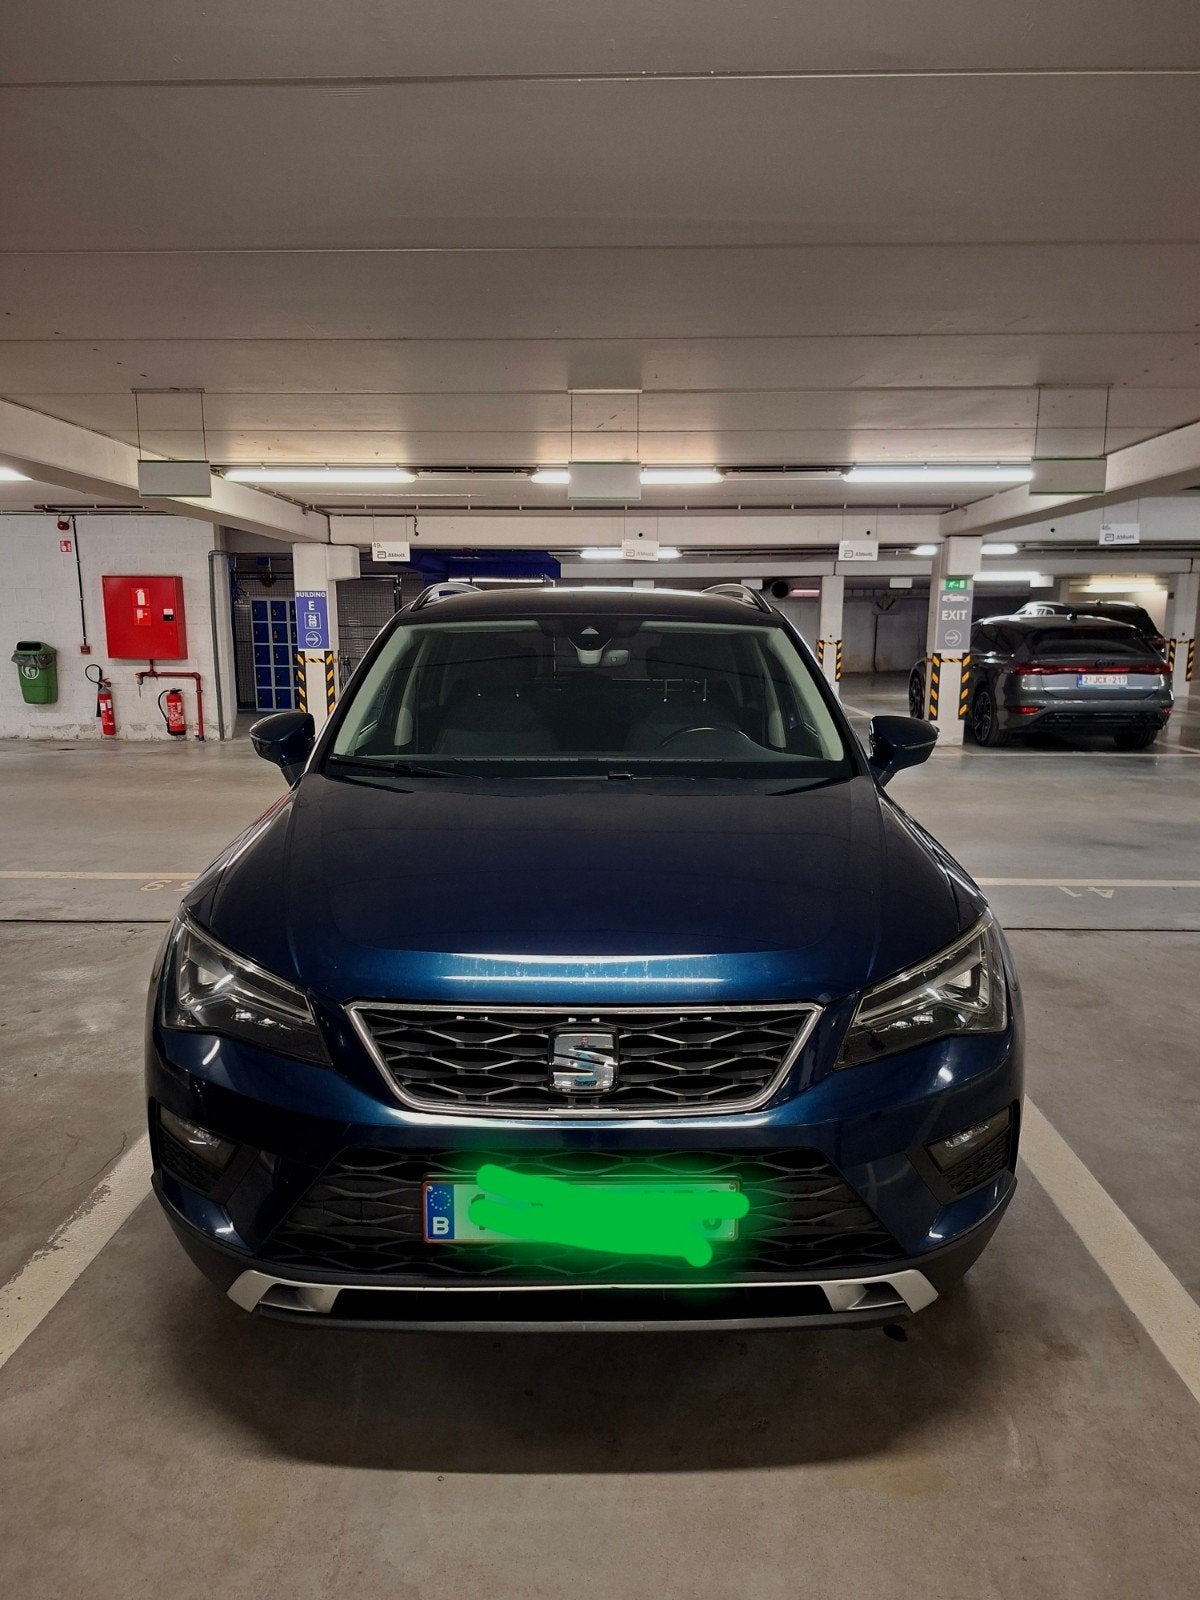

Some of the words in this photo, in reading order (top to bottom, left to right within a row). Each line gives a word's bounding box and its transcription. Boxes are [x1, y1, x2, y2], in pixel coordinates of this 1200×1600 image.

[308, 600, 315, 611] E
[941, 609, 968, 621] EXIT
[432, 1216, 450, 1235] B
